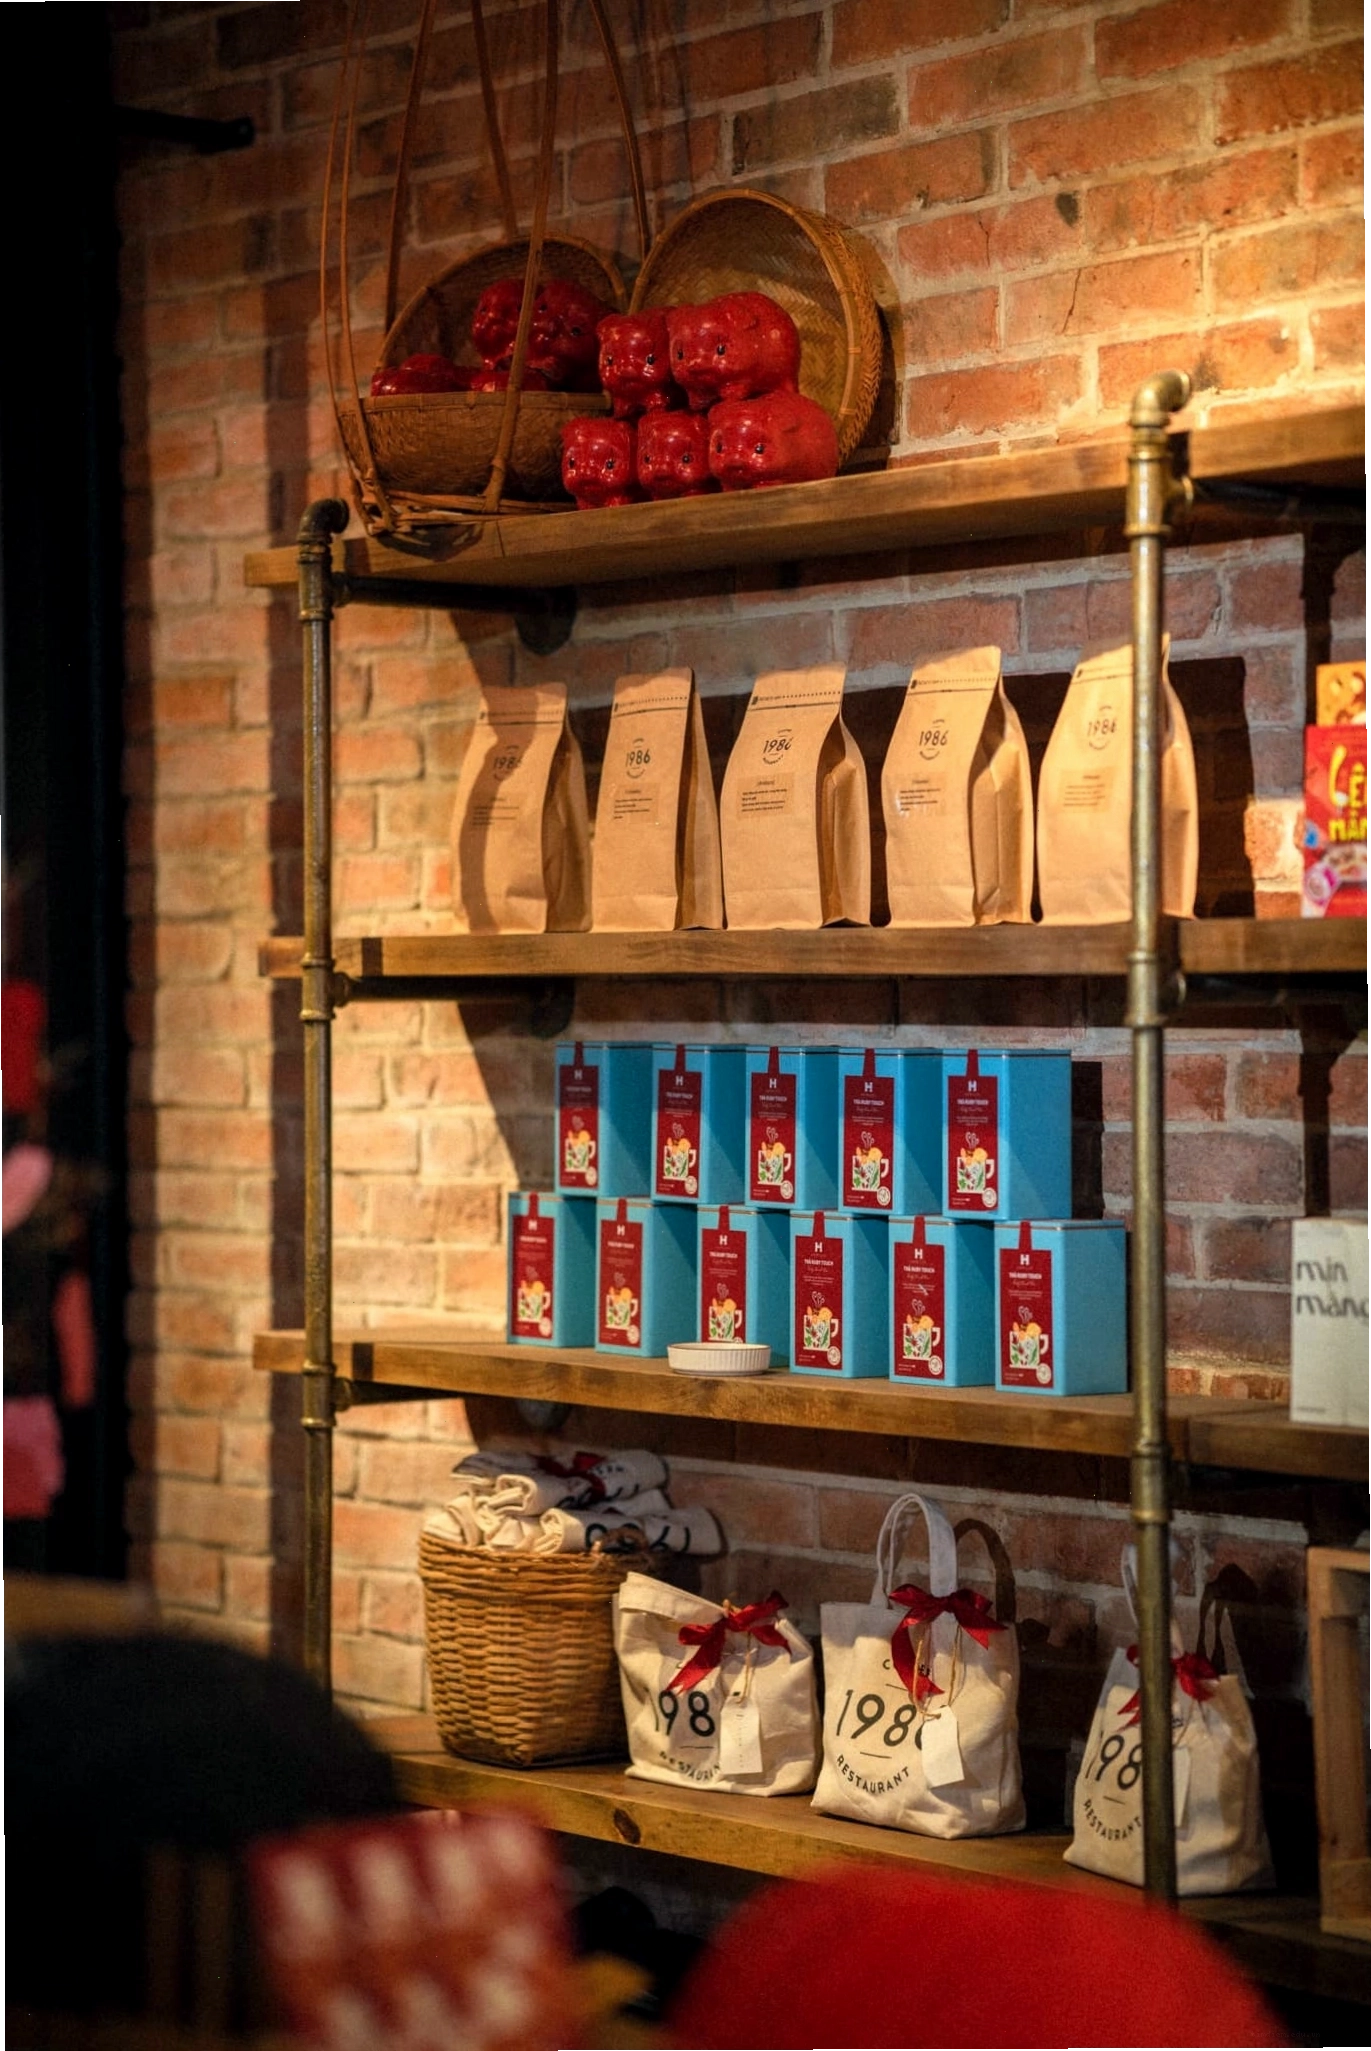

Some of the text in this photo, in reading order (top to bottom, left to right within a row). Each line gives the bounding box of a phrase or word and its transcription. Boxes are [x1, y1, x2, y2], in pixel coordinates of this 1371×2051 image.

[763, 736, 794, 754] 1986
[919, 729, 949, 746] 1986
[625, 748, 651, 767] 1986
[675, 1075, 684, 1087] H
[769, 1078, 777, 1089] H
[864, 1081, 873, 1093] H
[968, 1080, 977, 1092] H
[719, 1235, 728, 1246] H
[814, 1241, 823, 1253] H
[914, 1248, 923, 1260] H
[1020, 1253, 1030, 1266] H
[643, 1684, 717, 1738] 198
[659, 1750, 721, 1782] RESTAURAN
[1084, 1730, 1142, 1791] 198
[836, 1753, 910, 1795] RESTAURANT
[1083, 1798, 1142, 1841] RESTAURANT
